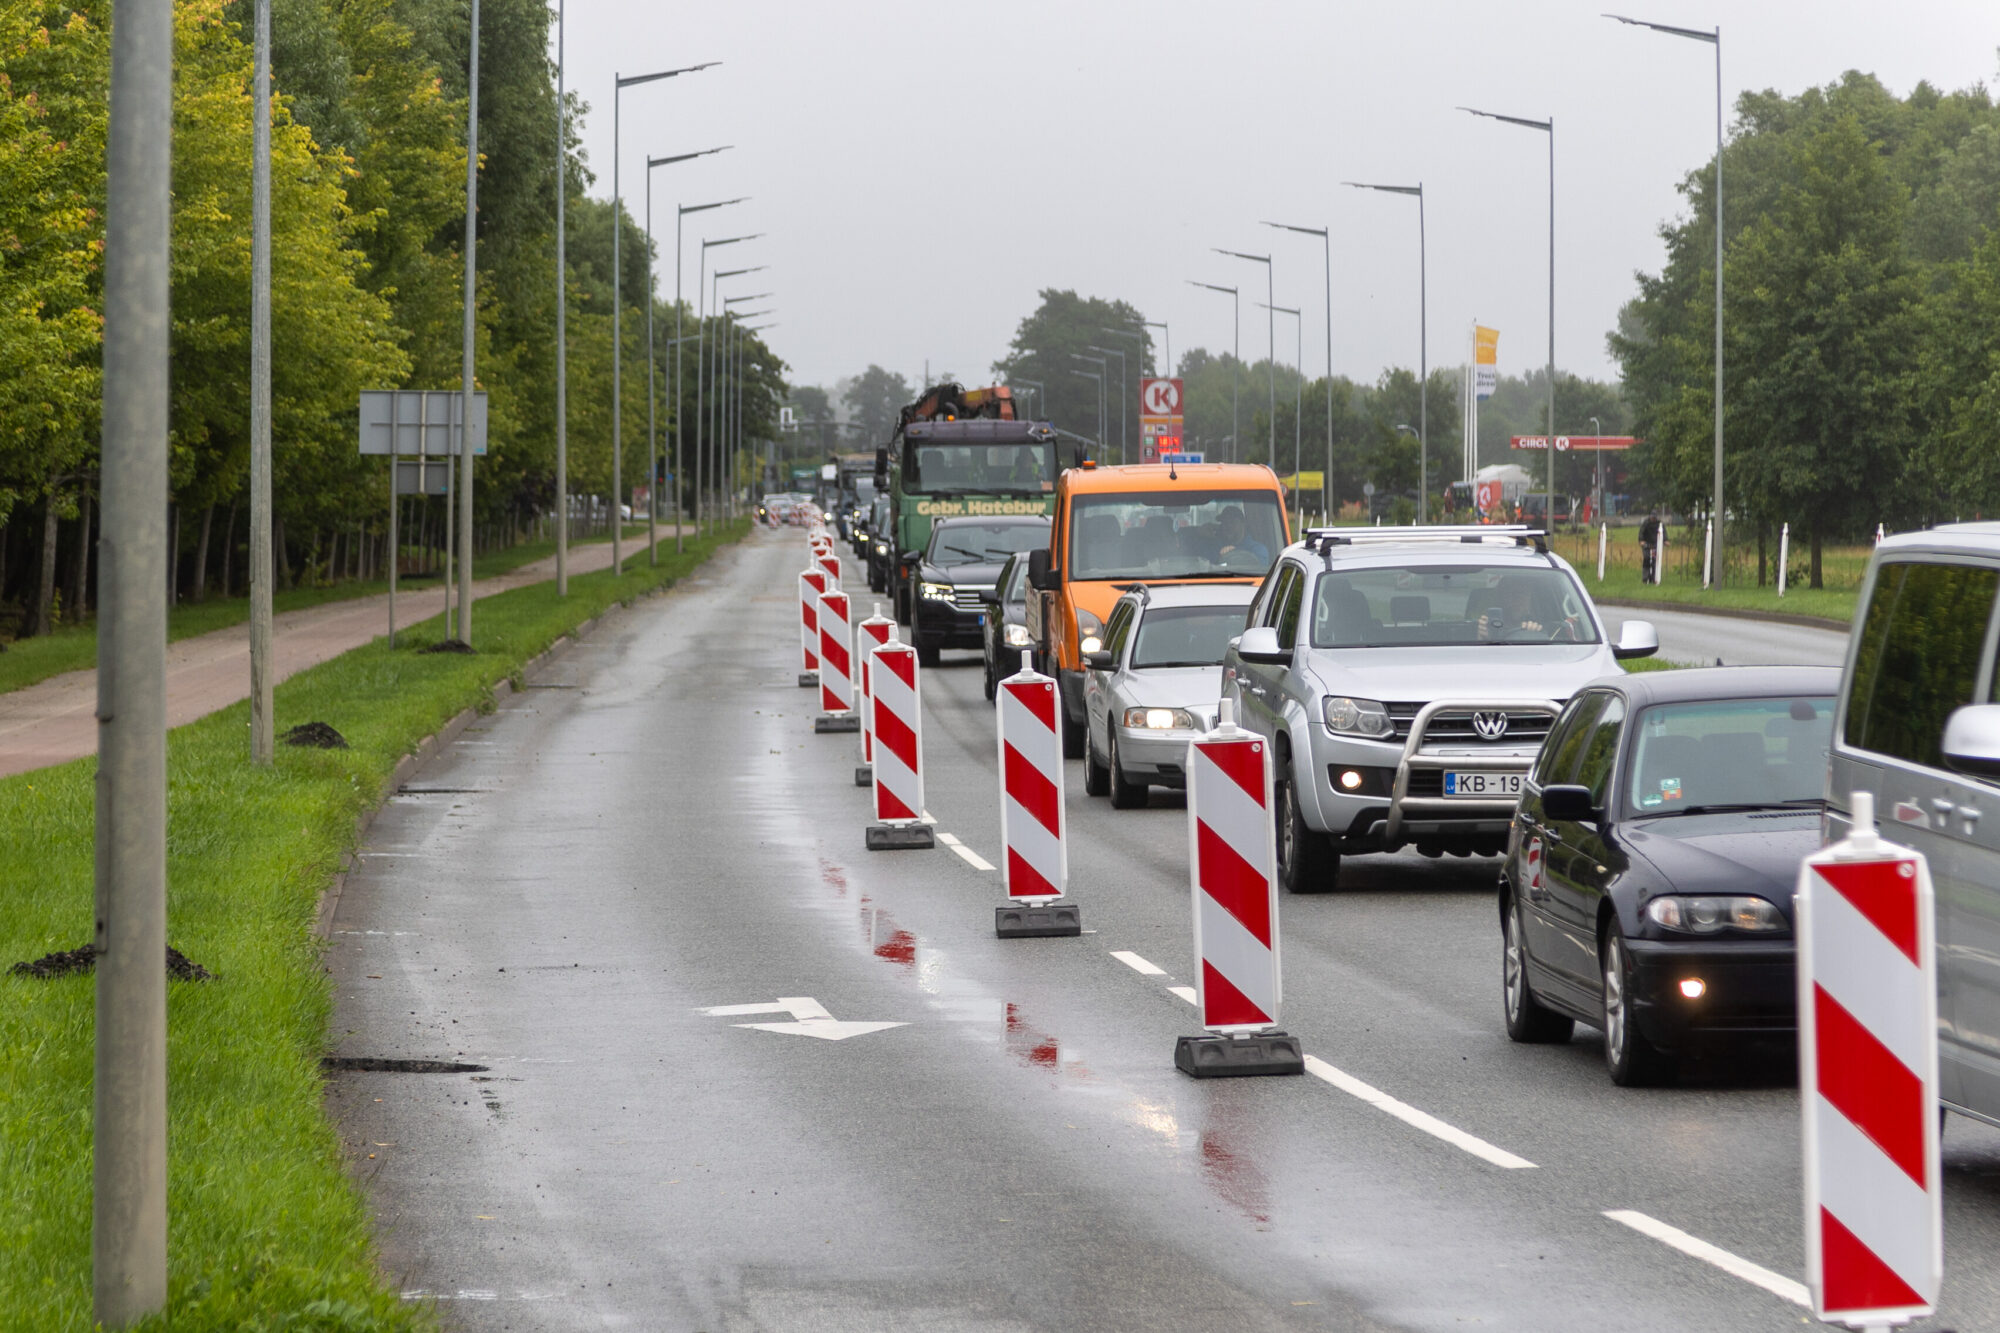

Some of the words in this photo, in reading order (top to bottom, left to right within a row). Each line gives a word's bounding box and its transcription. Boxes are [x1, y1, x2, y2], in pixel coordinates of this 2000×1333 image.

[1152, 385, 1176, 411] K
[1519, 438, 1549, 448] CIRCL
[917, 501, 966, 515] Gebr.
[968, 501, 1047, 515] Hatebur
[1460, 775, 1528, 792] KB-19
